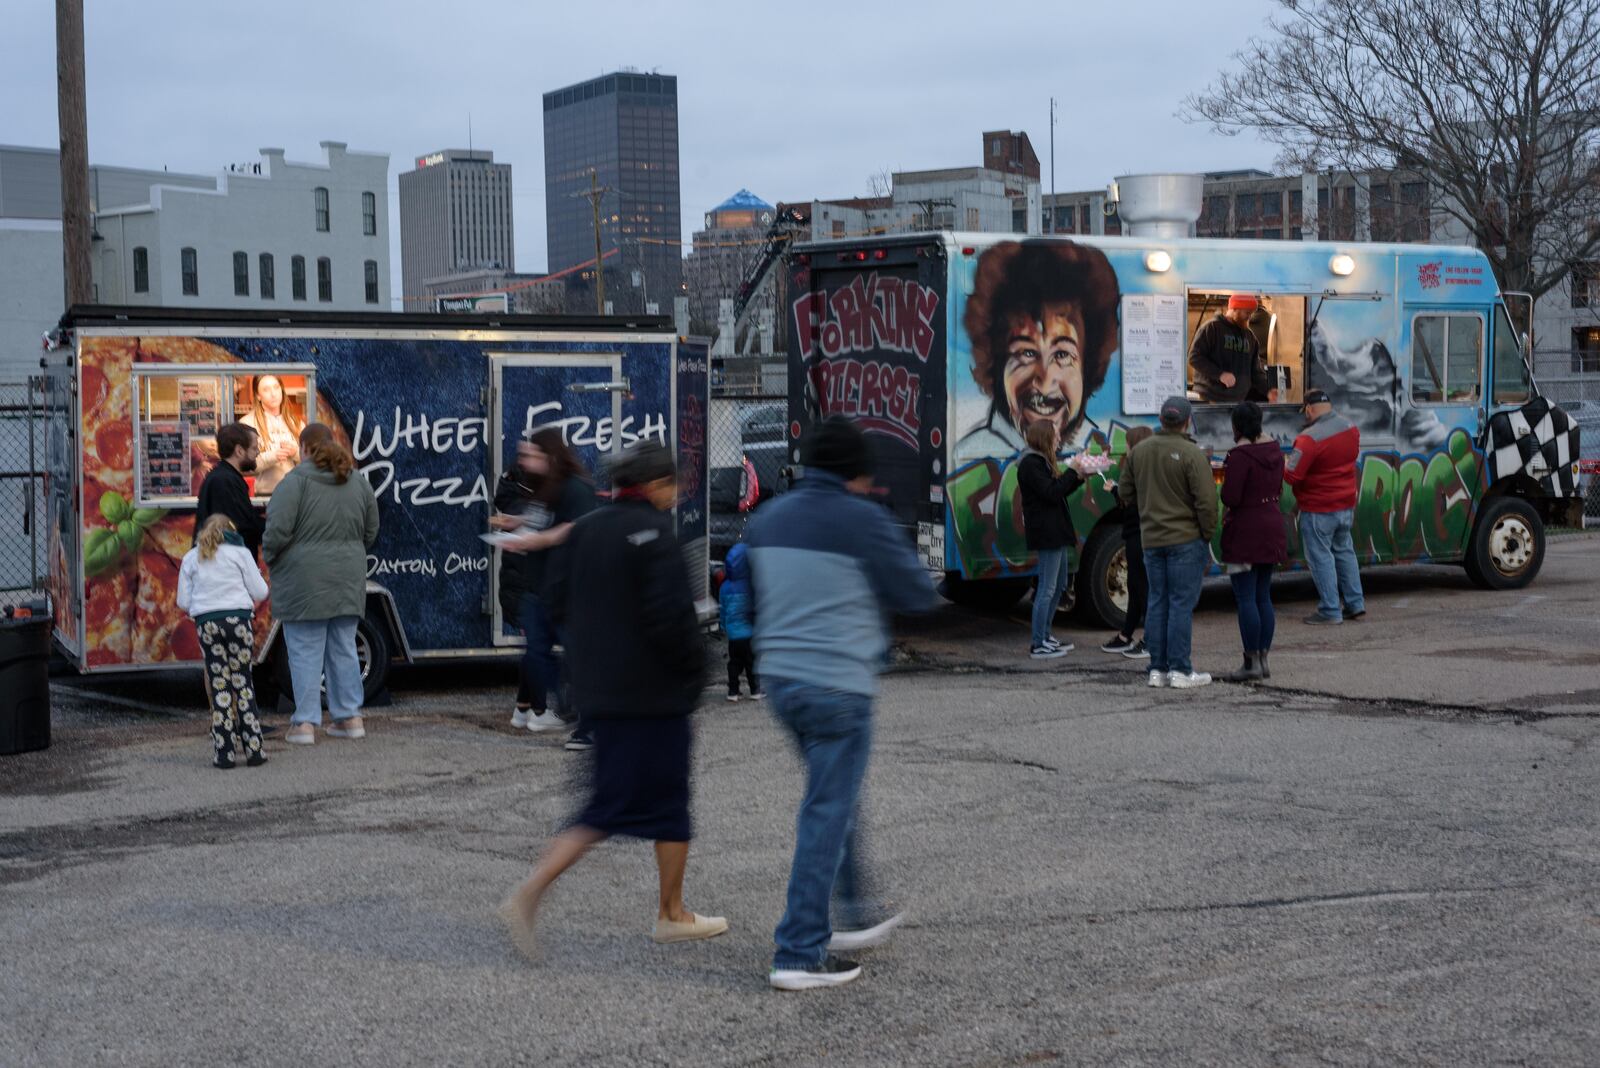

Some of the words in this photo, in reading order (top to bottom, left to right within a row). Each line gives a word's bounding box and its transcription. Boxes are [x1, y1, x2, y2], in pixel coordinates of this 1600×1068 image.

[793, 271, 940, 363] FORKING
[805, 358, 922, 436] PIEROGI
[522, 401, 667, 451] FRESH
[354, 460, 488, 508] PIZZA
[365, 554, 437, 578] DAYTON,
[444, 552, 489, 574] OHIO
